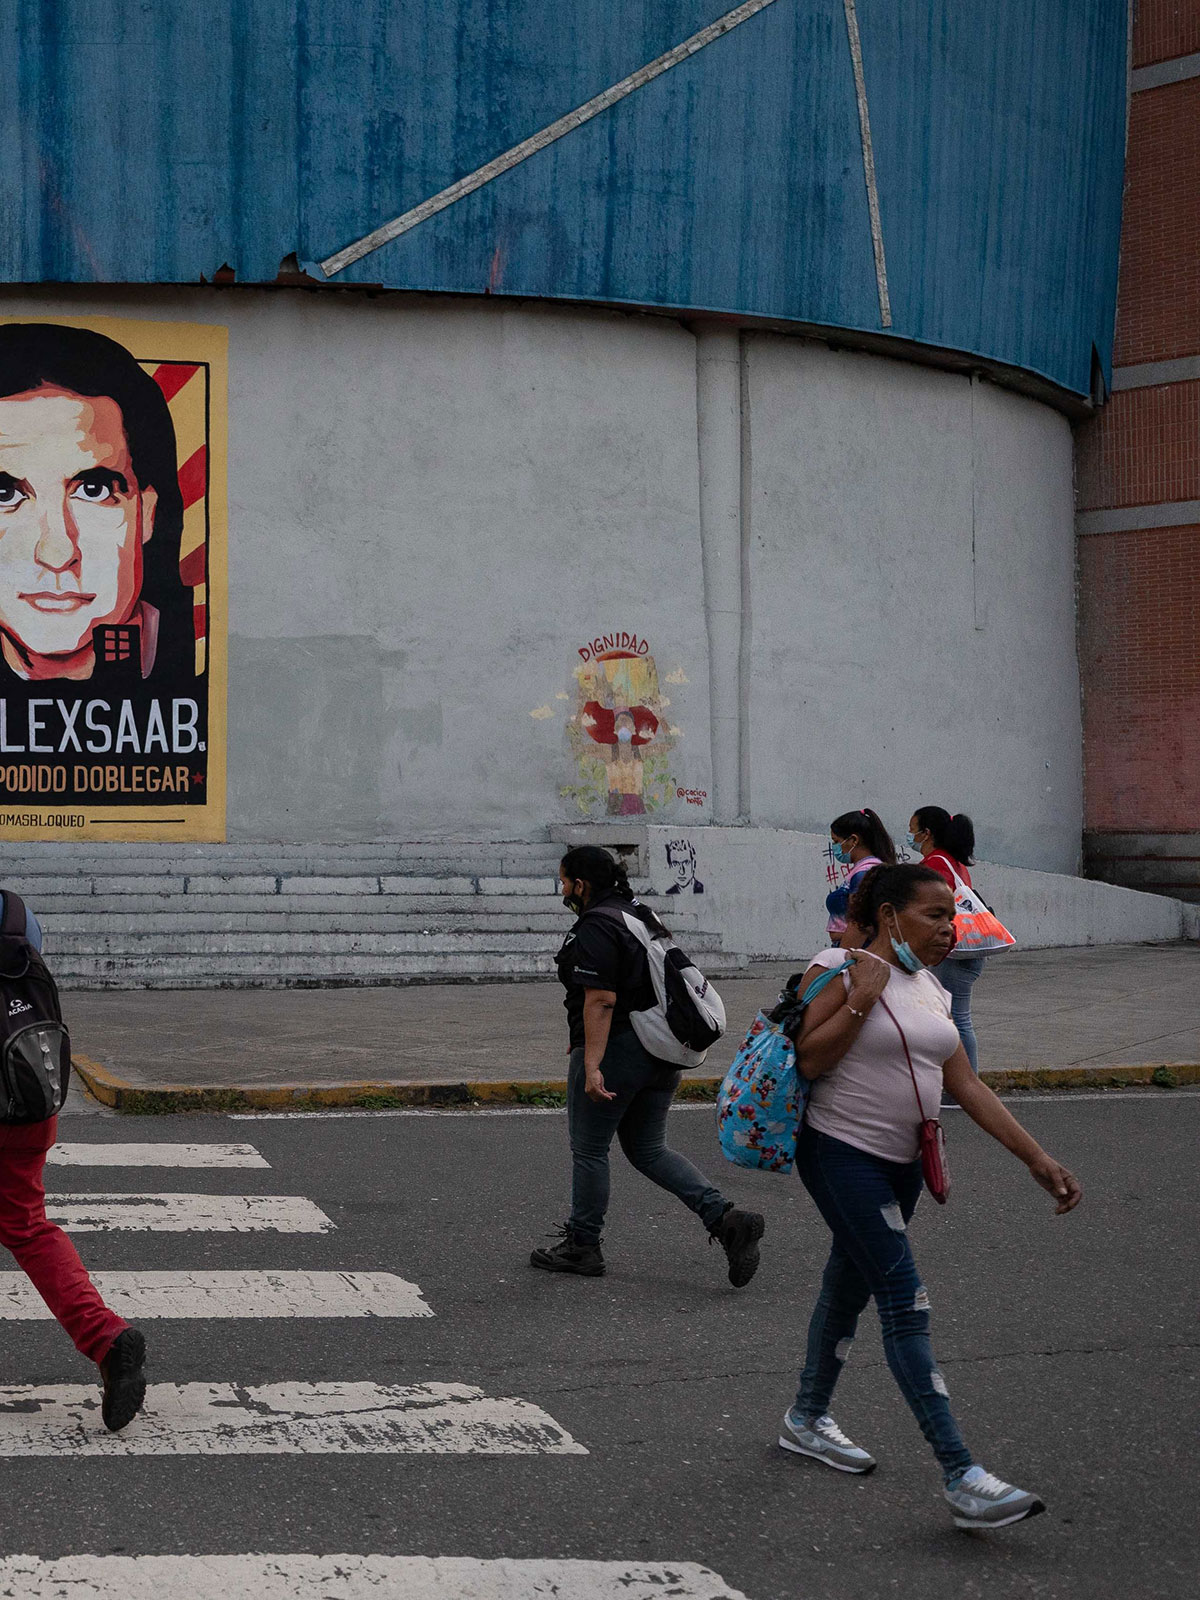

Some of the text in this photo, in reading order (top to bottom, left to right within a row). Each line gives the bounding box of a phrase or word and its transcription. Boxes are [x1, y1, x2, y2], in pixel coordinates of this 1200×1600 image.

[578, 631, 649, 663] DIGNIDAD
[73, 765, 190, 793] DOBLEGAR
[8, 1003, 33, 1017] ACADIA
